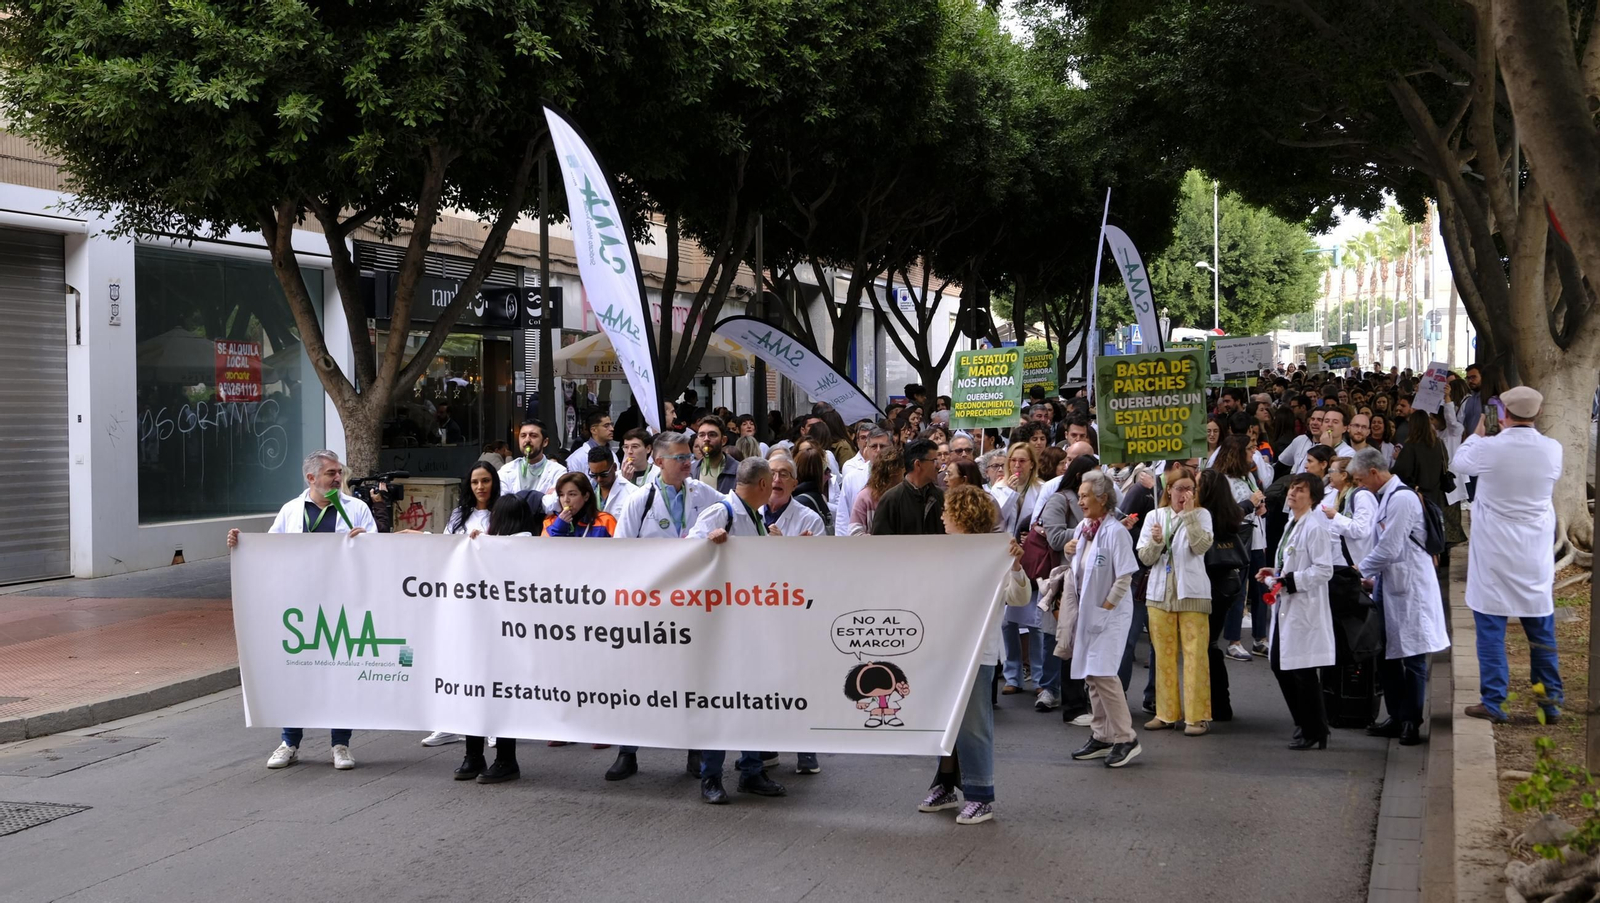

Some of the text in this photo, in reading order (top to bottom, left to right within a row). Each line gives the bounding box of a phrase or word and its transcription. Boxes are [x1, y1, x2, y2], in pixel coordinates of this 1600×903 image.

[217, 342, 260, 357] SE ALQUILA
[226, 355, 250, 369] LOCAL
[961, 352, 1018, 366] EL ESTATUTO
[1024, 353, 1054, 363] ESTATUTO
[968, 364, 1009, 377] MARCO
[1116, 359, 1191, 378] BASTA DE
[957, 376, 1015, 389] NOS IGNORA
[1113, 375, 1187, 393] PARCHES
[966, 392, 1004, 401] QUEREMOS
[1109, 392, 1201, 411] QUEREMOS UN
[954, 400, 1015, 410] RECONOCIMIENTO,
[955, 408, 1013, 418] NO PRECARIEDAD
[1114, 406, 1191, 425] ESTATUTO
[1125, 421, 1183, 439] MÉDICO
[1127, 438, 1183, 455] PROPIO
[402, 576, 814, 613] Con este Estatuto nos explotáis,
[852, 615, 901, 625] NO AL
[281, 603, 407, 662] SMA
[501, 620, 692, 650] no nos reguláis
[836, 627, 918, 637] ESTATUTO
[849, 638, 905, 648] MARCO!
[286, 659, 313, 667] Sindicato
[314, 659, 336, 667] Médico
[336, 659, 360, 668] Andaluz
[364, 660, 396, 668] Federación
[357, 669, 410, 683] Almería
[435, 677, 808, 711] Por un Estatuto propio del Facultativo
